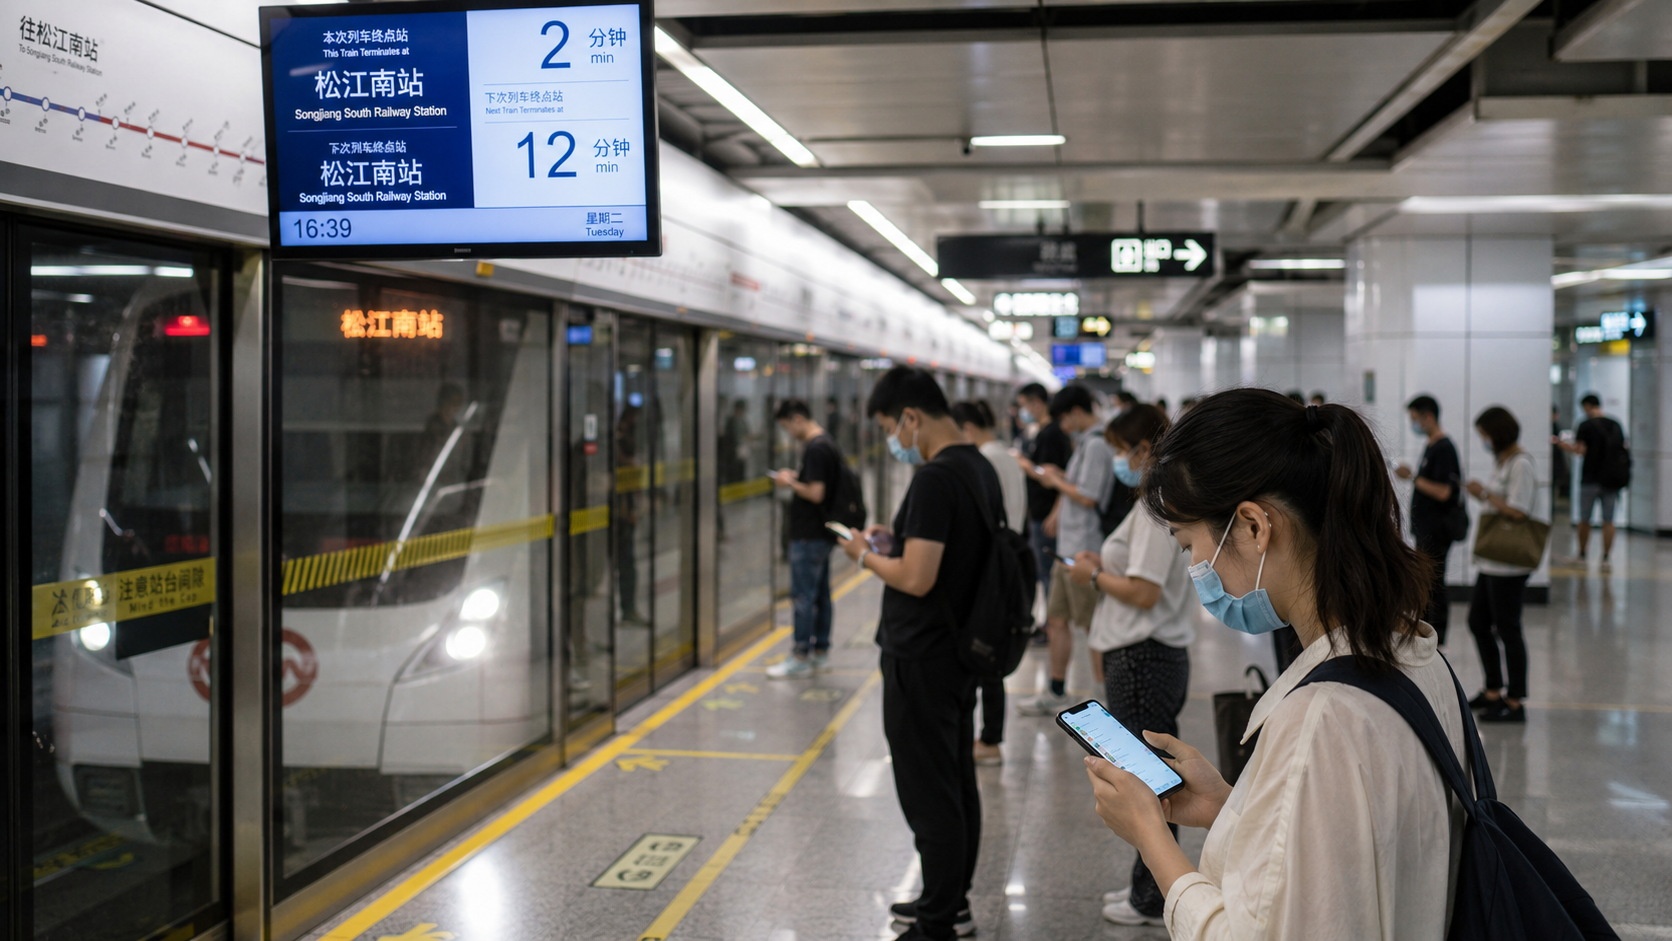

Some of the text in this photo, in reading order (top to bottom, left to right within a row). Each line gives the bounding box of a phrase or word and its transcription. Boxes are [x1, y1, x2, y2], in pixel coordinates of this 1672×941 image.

[19, 15, 98, 62] 往松江南站
[322, 27, 409, 45] 本次列车终点站
[540, 20, 627, 69] 2 分钟
[322, 48, 340, 58] This
[340, 48, 359, 57] Train
[401, 46, 410, 56] at
[590, 52, 615, 64] min
[314, 67, 424, 100] 松江南站
[295, 105, 448, 122] Songjiang South Railway Station
[485, 106, 501, 115] Next
[502, 106, 519, 115] Train
[556, 105, 565, 114] at
[517, 130, 631, 179] 12 分钟
[319, 158, 423, 188] 松江南站
[595, 160, 619, 173] min
[299, 190, 447, 205] Songjiang South Railway Station
[585, 211, 624, 225] 星期二
[293, 217, 352, 239] 16:39
[585, 227, 625, 238] Tuesday
[340, 308, 444, 339] 松江南站
[129, 598, 154, 614] Mind
